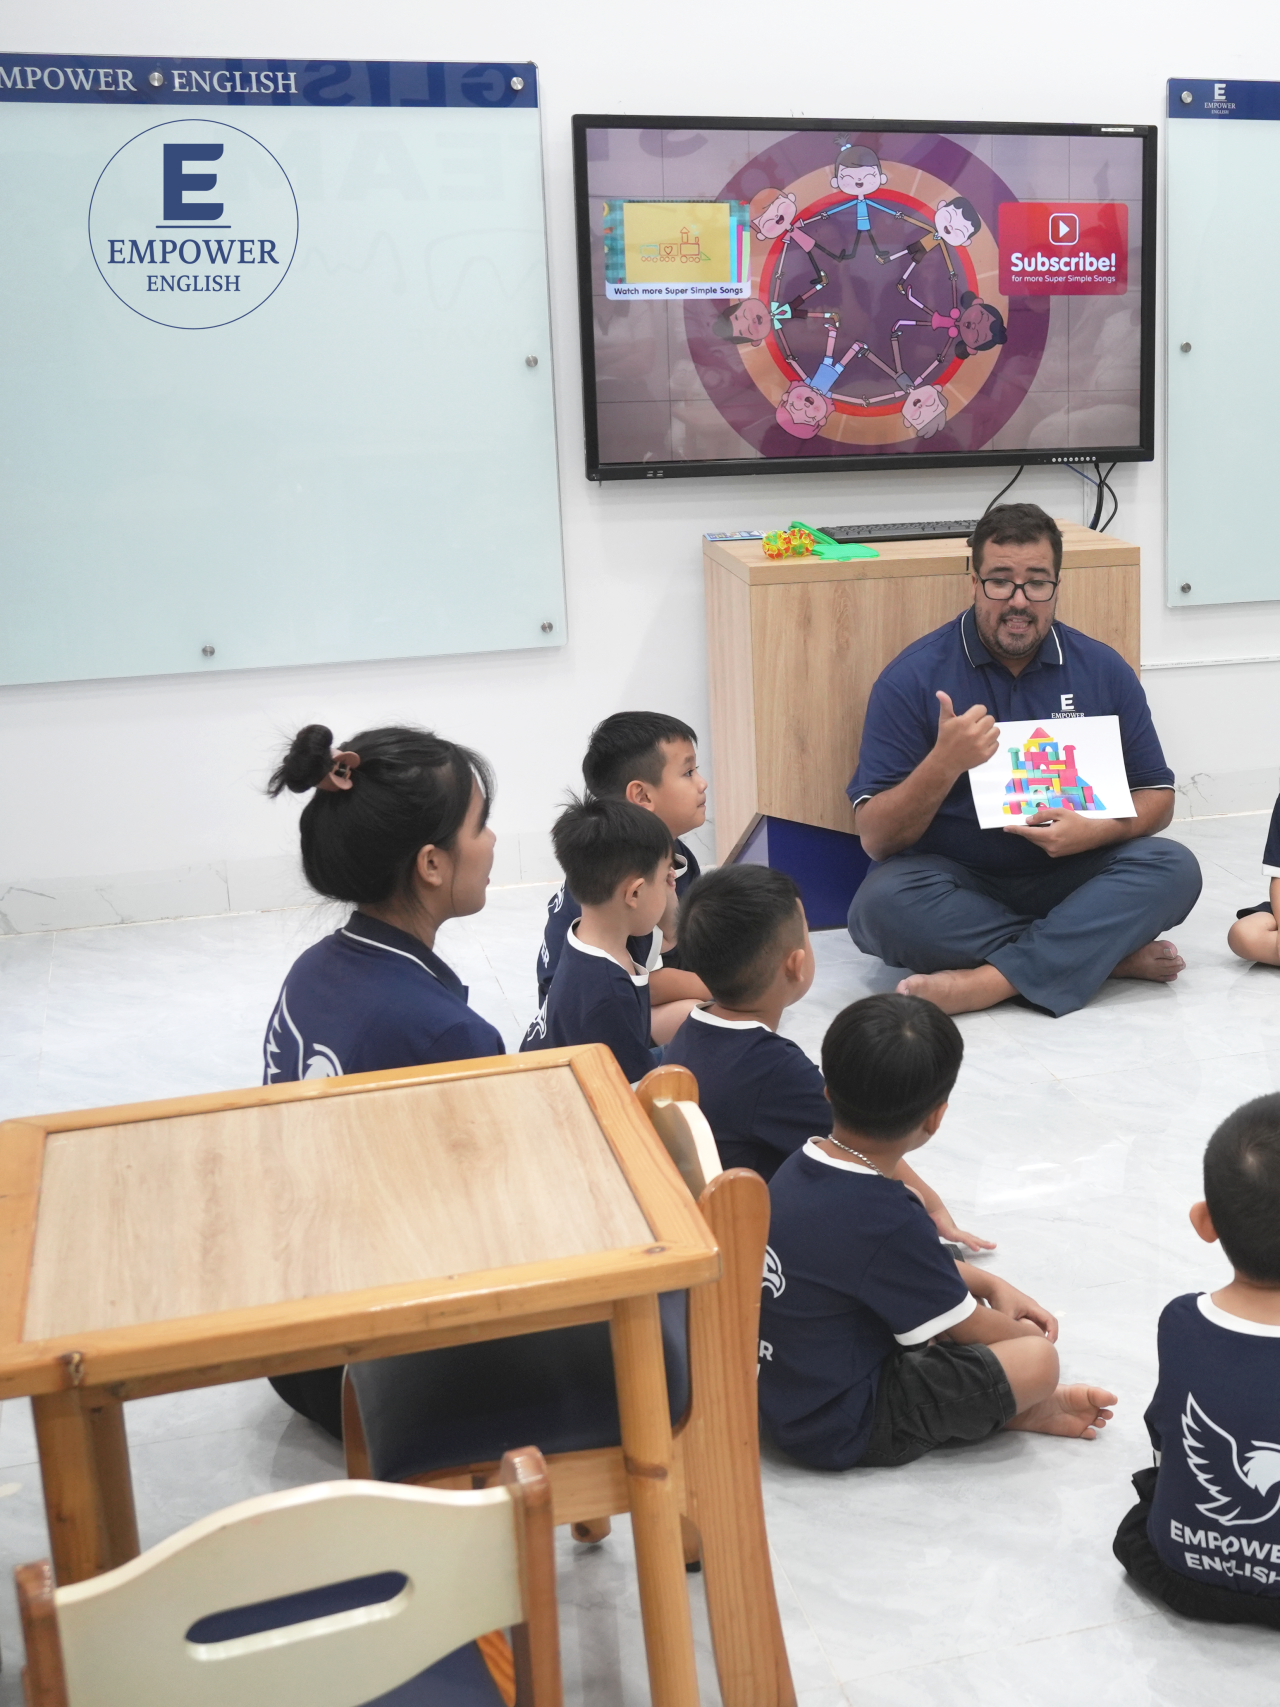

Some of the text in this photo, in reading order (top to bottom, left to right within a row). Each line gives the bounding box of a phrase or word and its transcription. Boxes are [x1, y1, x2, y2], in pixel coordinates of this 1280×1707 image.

[171, 69, 298, 94] ENGLISH
[1214, 83, 1227, 100] E
[163, 143, 224, 221] E
[107, 239, 280, 265] EMPOWER
[1010, 251, 1116, 272] Subscribe!
[146, 274, 241, 292] ENGLISH
[1044, 275, 1066, 283] Super
[1067, 275, 1092, 283] Simple
[1093, 275, 1116, 284] Songs
[614, 287, 639, 295] Watch
[665, 287, 688, 297] Super
[690, 286, 717, 297] Simple
[719, 286, 743, 296] Songs
[1061, 693, 1075, 710] E
